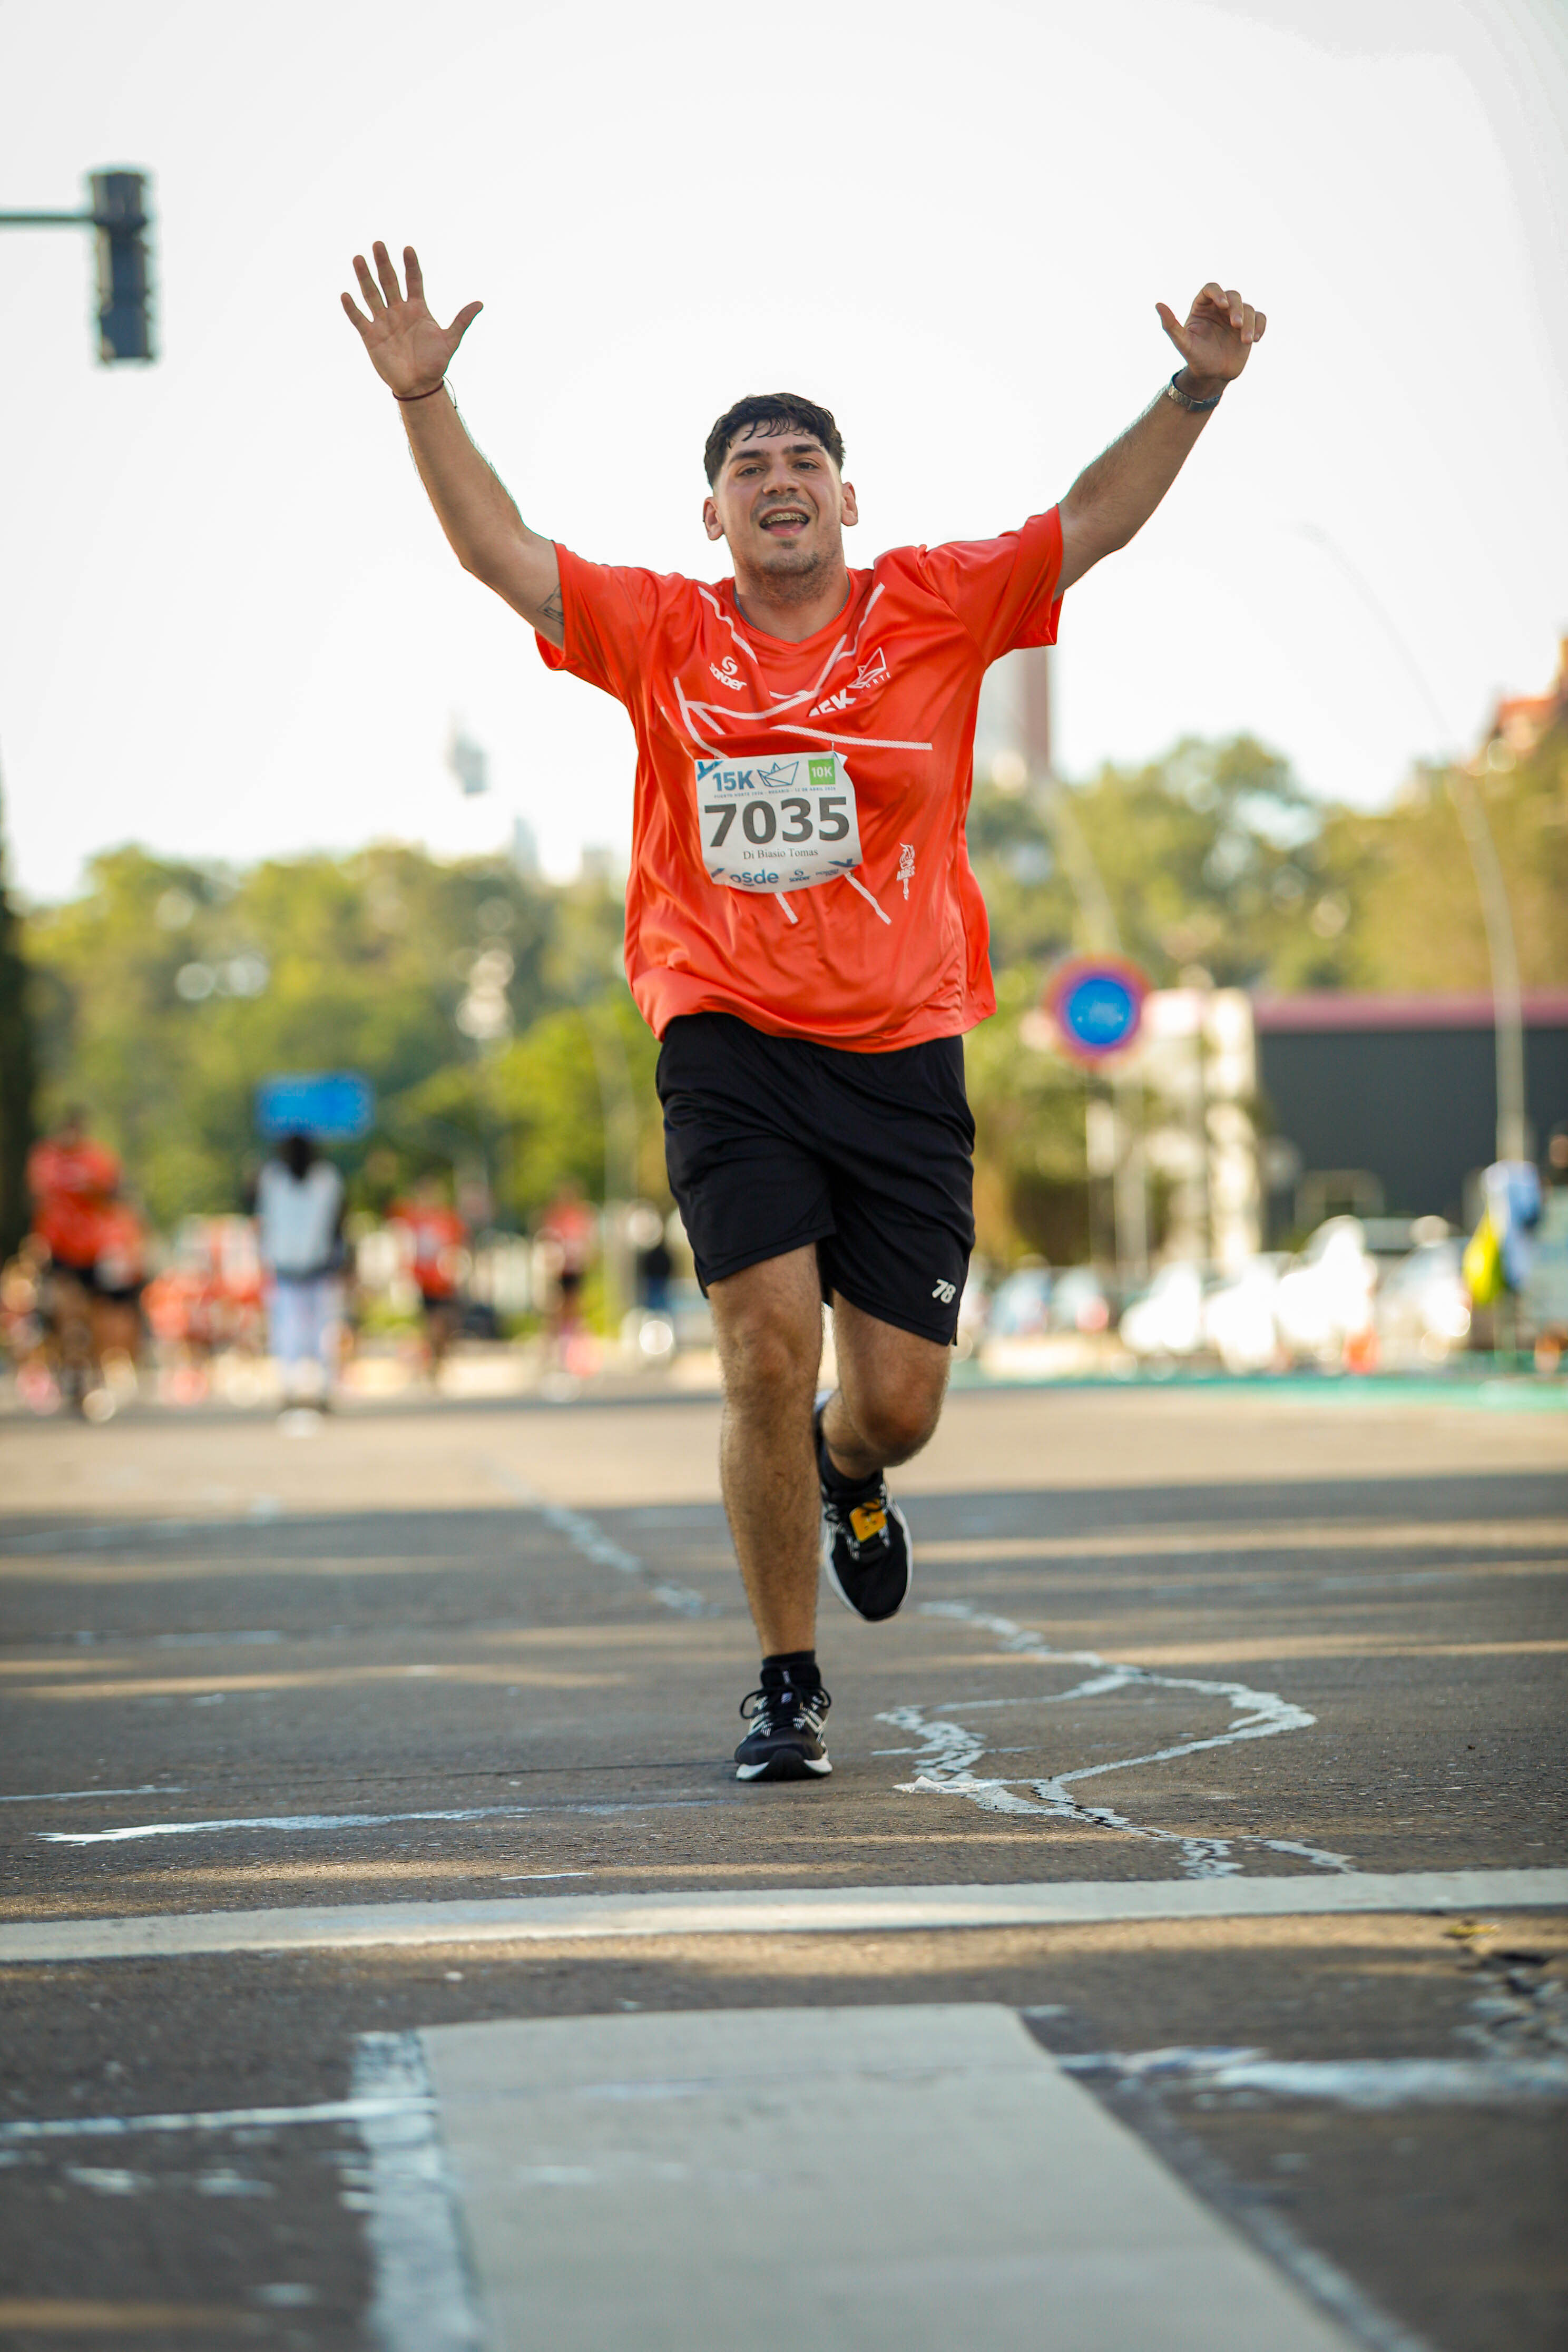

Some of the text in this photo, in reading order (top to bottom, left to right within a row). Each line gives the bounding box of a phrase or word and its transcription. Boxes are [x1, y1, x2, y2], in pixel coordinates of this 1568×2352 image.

[712, 770, 756, 791] 15K
[811, 766, 832, 778] 10K
[704, 796, 849, 847] 7035
[743, 848, 818, 860] Di Biasio Tomas
[730, 869, 779, 885] osde
[932, 1278, 956, 1304] 78
